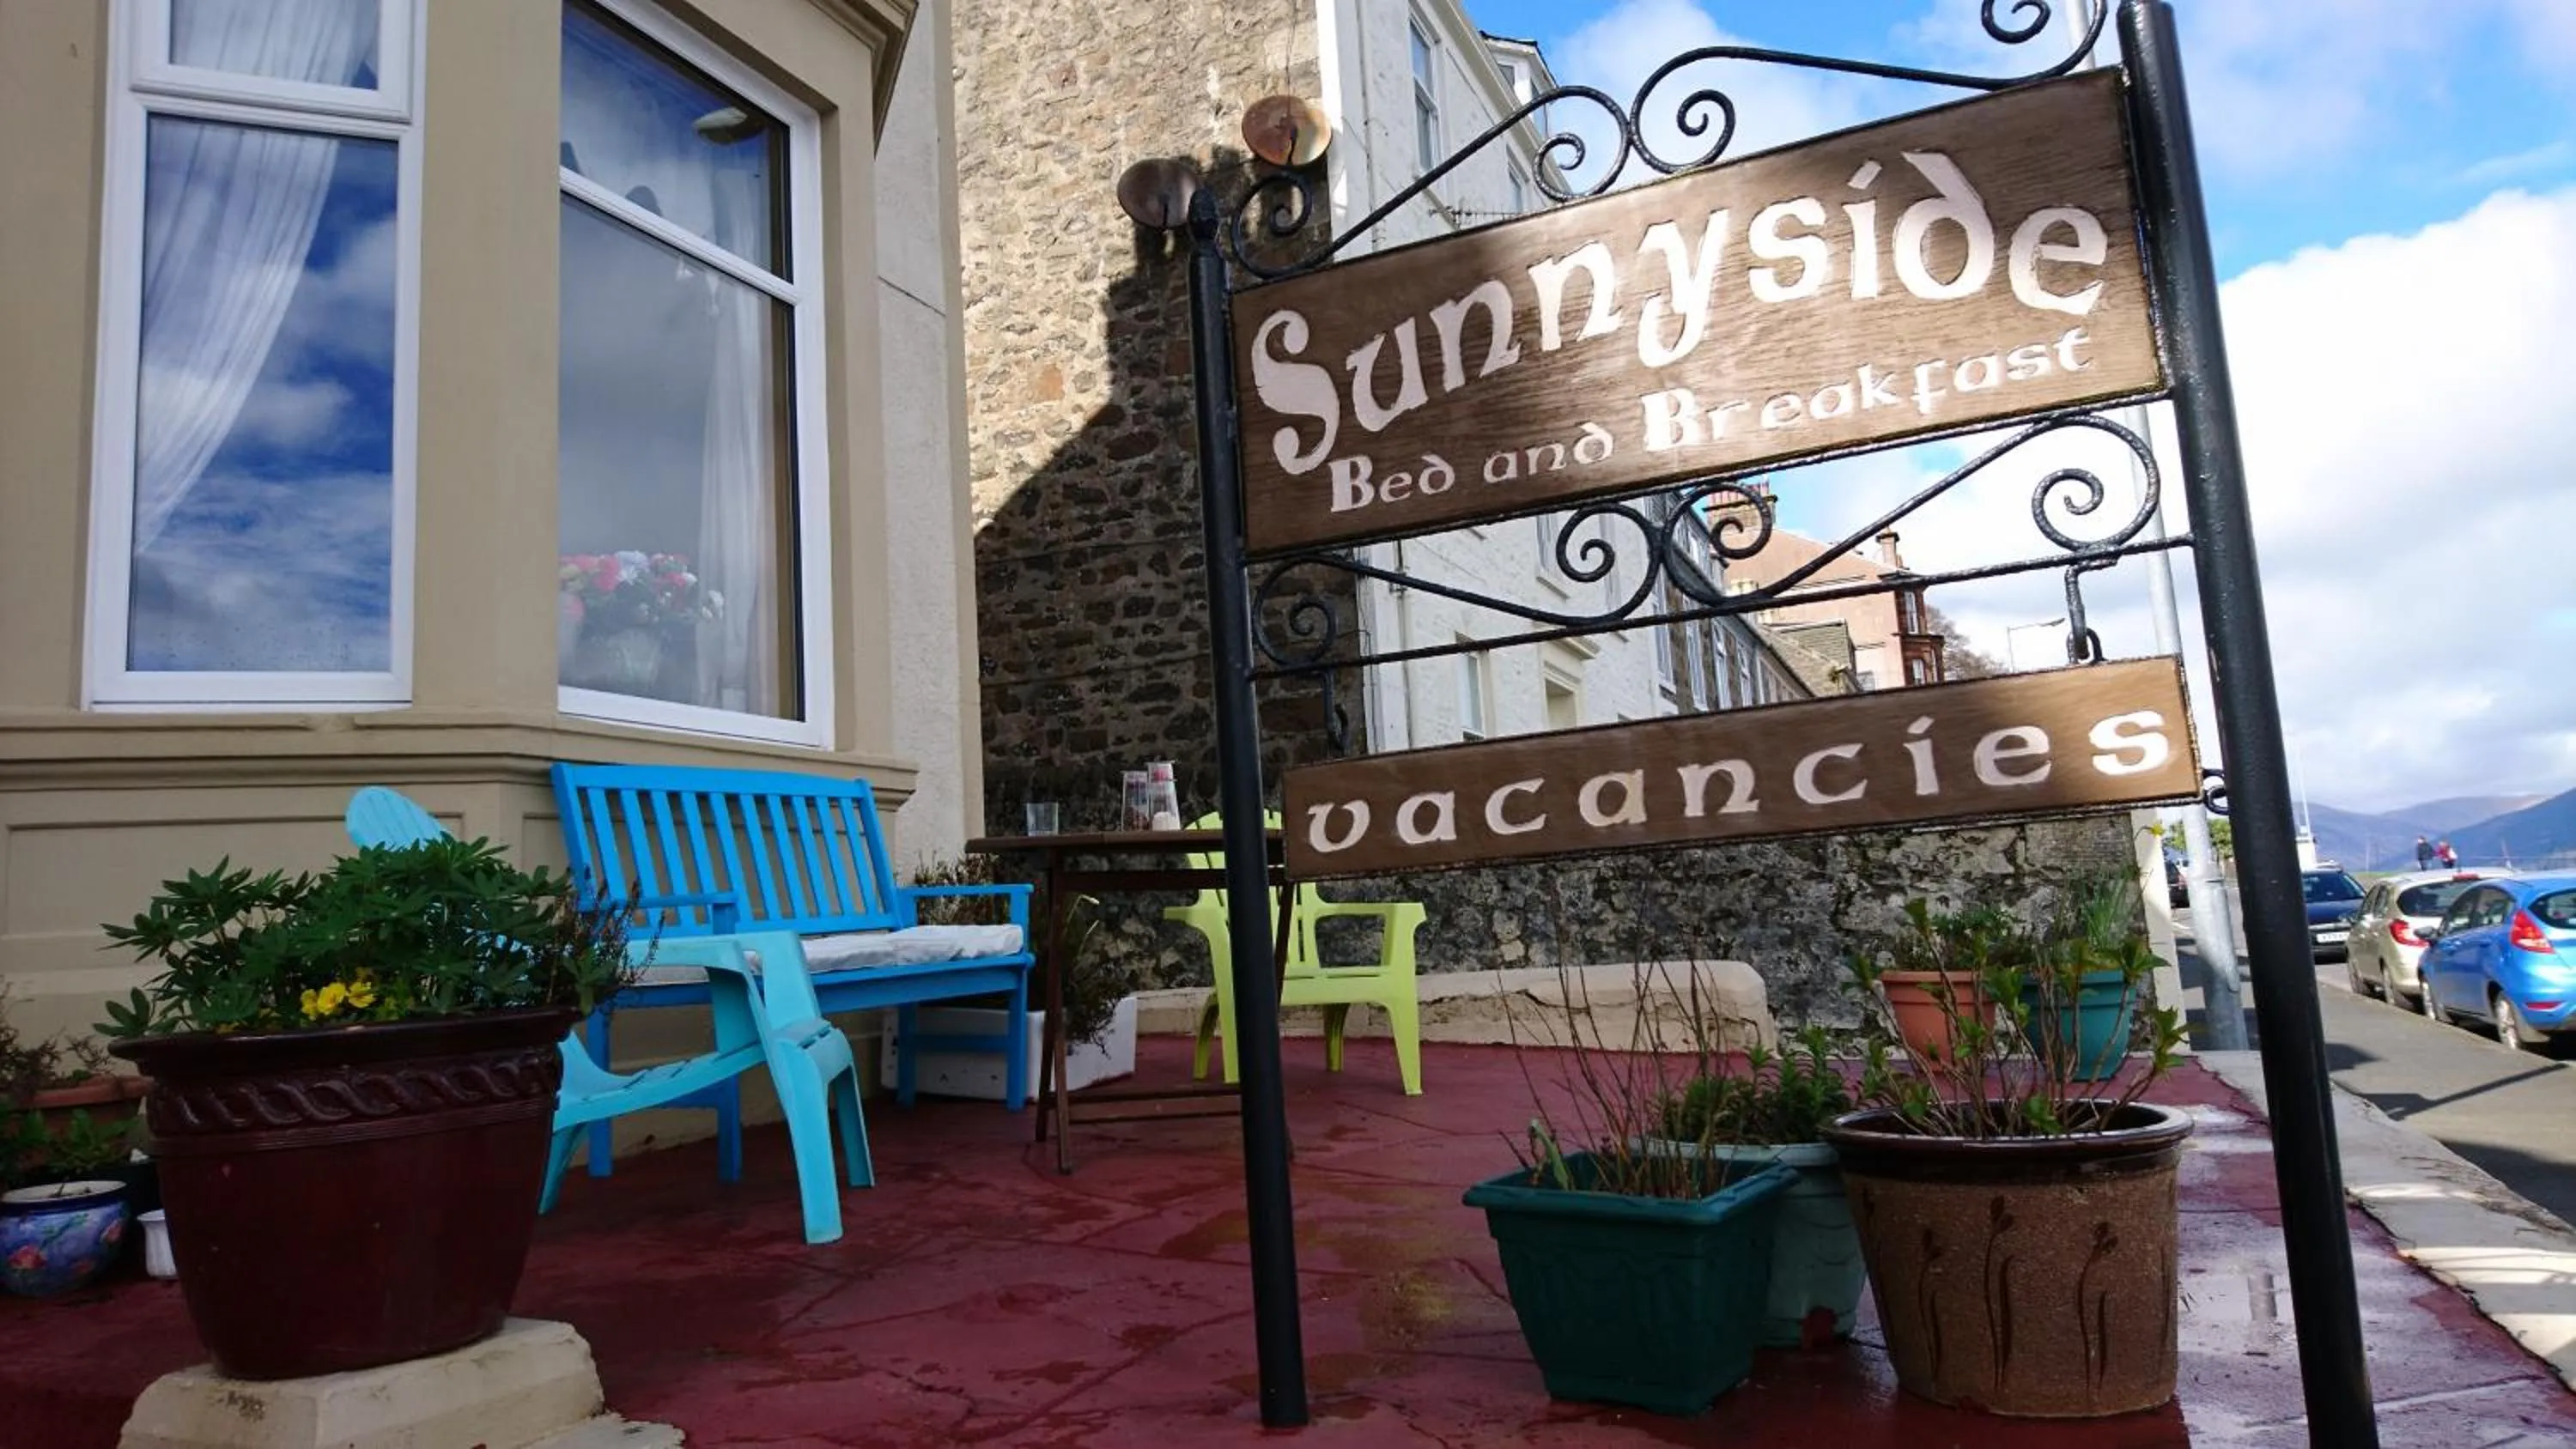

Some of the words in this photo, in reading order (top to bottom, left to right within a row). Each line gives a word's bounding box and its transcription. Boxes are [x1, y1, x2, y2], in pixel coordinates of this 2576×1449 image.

[1252, 149, 2109, 475] Sunnyside
[1329, 457, 1455, 512] Bed
[1483, 421, 1615, 485] and
[1640, 326, 2093, 452] Breakfast
[1308, 709, 2169, 852] vacancies
